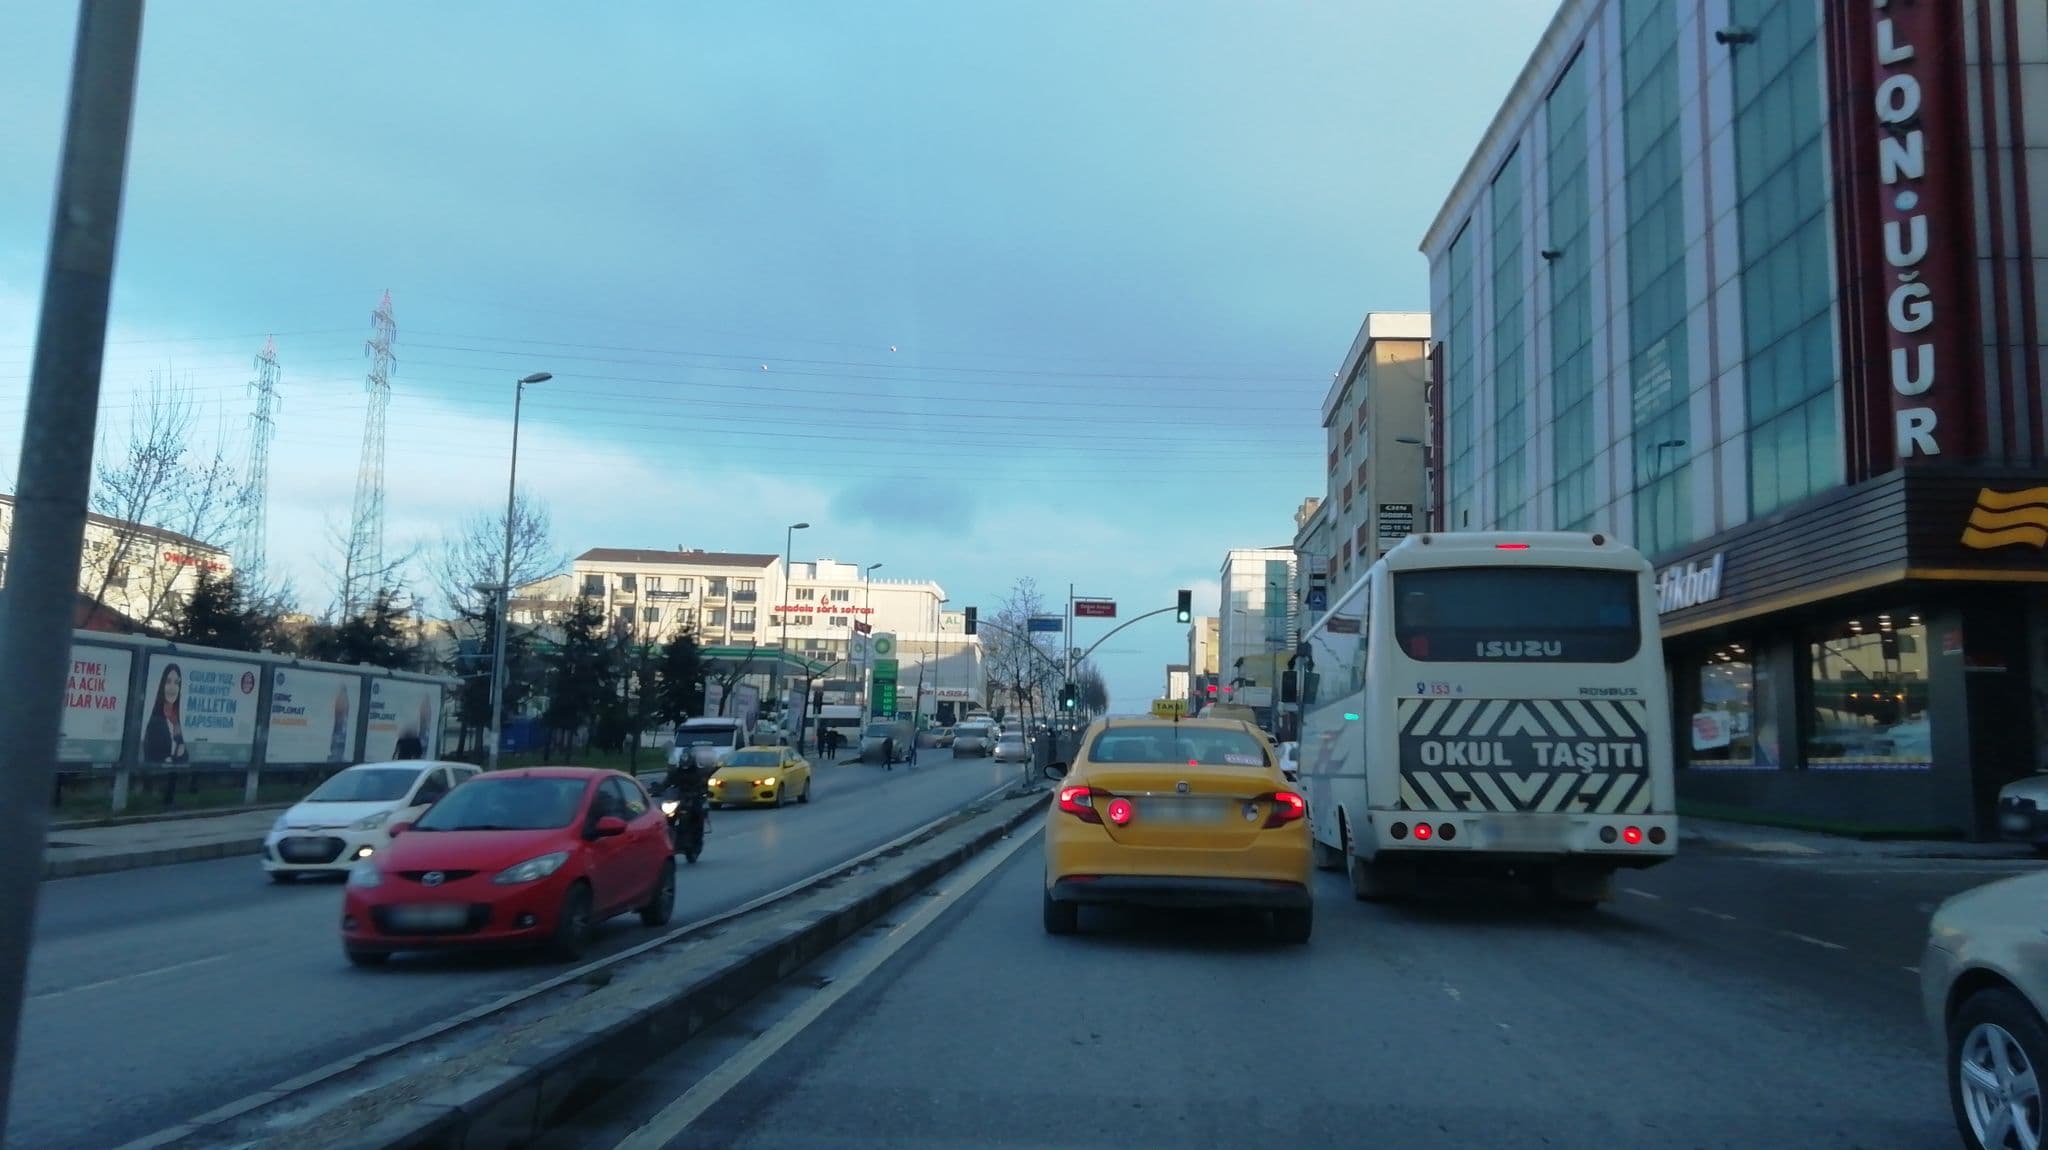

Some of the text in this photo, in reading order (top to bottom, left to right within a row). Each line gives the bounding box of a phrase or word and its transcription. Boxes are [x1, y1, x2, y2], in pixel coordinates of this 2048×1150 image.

[1873, 0, 1941, 458] LON UĞUR
[944, 616, 961, 624] AL
[1475, 640, 1562, 657] ISUZU
[94, 695, 117, 711] VAR
[1420, 740, 1644, 774] OKUL TAŞITI
